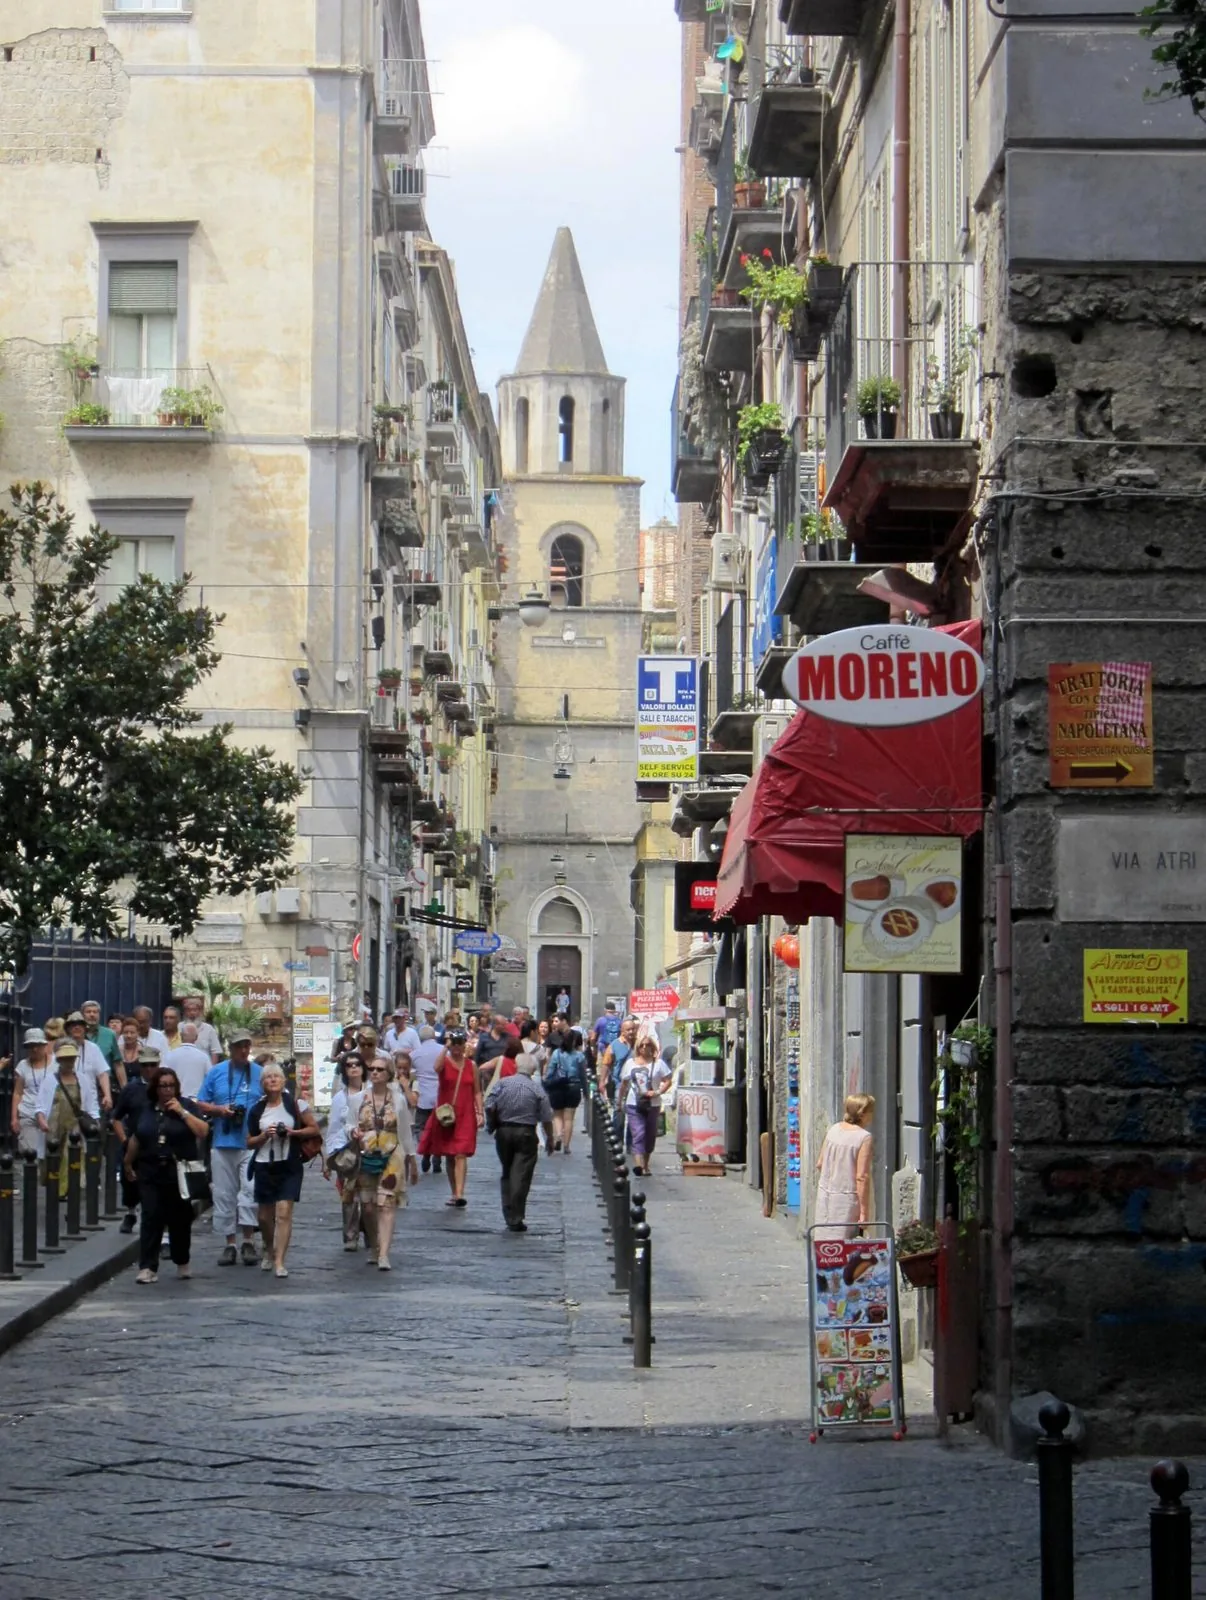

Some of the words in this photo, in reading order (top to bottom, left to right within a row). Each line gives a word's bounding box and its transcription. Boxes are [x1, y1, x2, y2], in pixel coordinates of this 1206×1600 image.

[860, 633, 910, 650] Caffè
[797, 650, 978, 701] MORENO
[644, 660, 692, 703] T
[1055, 671, 1144, 696] TRATTORIA
[1068, 695, 1090, 704] CON
[640, 714, 655, 722] SALI
[662, 714, 694, 722] TABACCHI
[1084, 708, 1117, 719] TIPICA
[1058, 722, 1147, 739] NAPOLETANA
[1122, 745, 1151, 755] CUISINE
[1111, 851, 1141, 869] VIA
[1157, 851, 1197, 869] ATRI
[694, 885, 717, 896] ner
[1094, 976, 1146, 984] FANTASTICHE
[1147, 975, 1178, 984] OFFERTE
[248, 987, 281, 1001] Insolito
[1108, 986, 1133, 994] TANTA
[1104, 1003, 1129, 1012] SOLI
